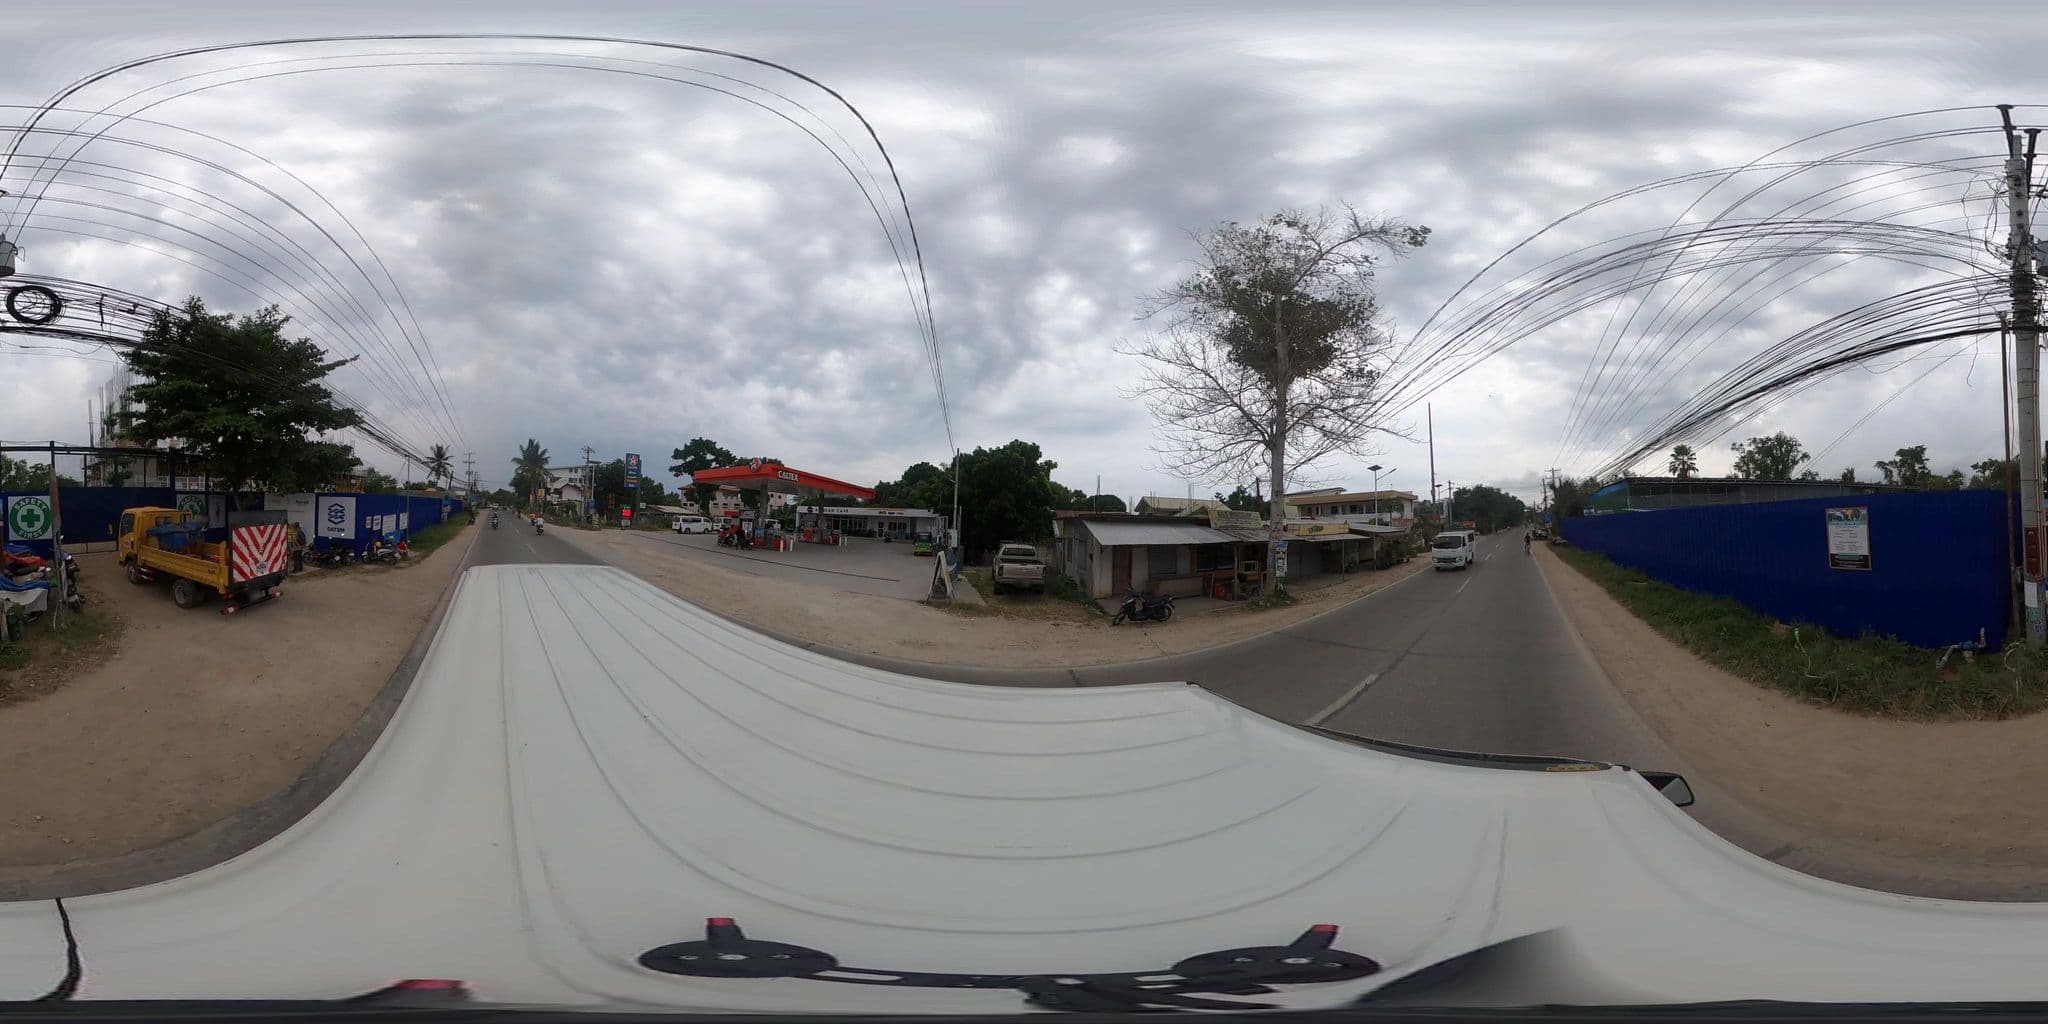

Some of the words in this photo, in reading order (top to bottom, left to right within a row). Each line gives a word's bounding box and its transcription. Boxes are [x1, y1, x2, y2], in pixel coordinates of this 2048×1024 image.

[778, 470, 799, 482] CALTEX
[14, 498, 48, 510] SAFETY
[18, 530, 44, 539] FIRST
